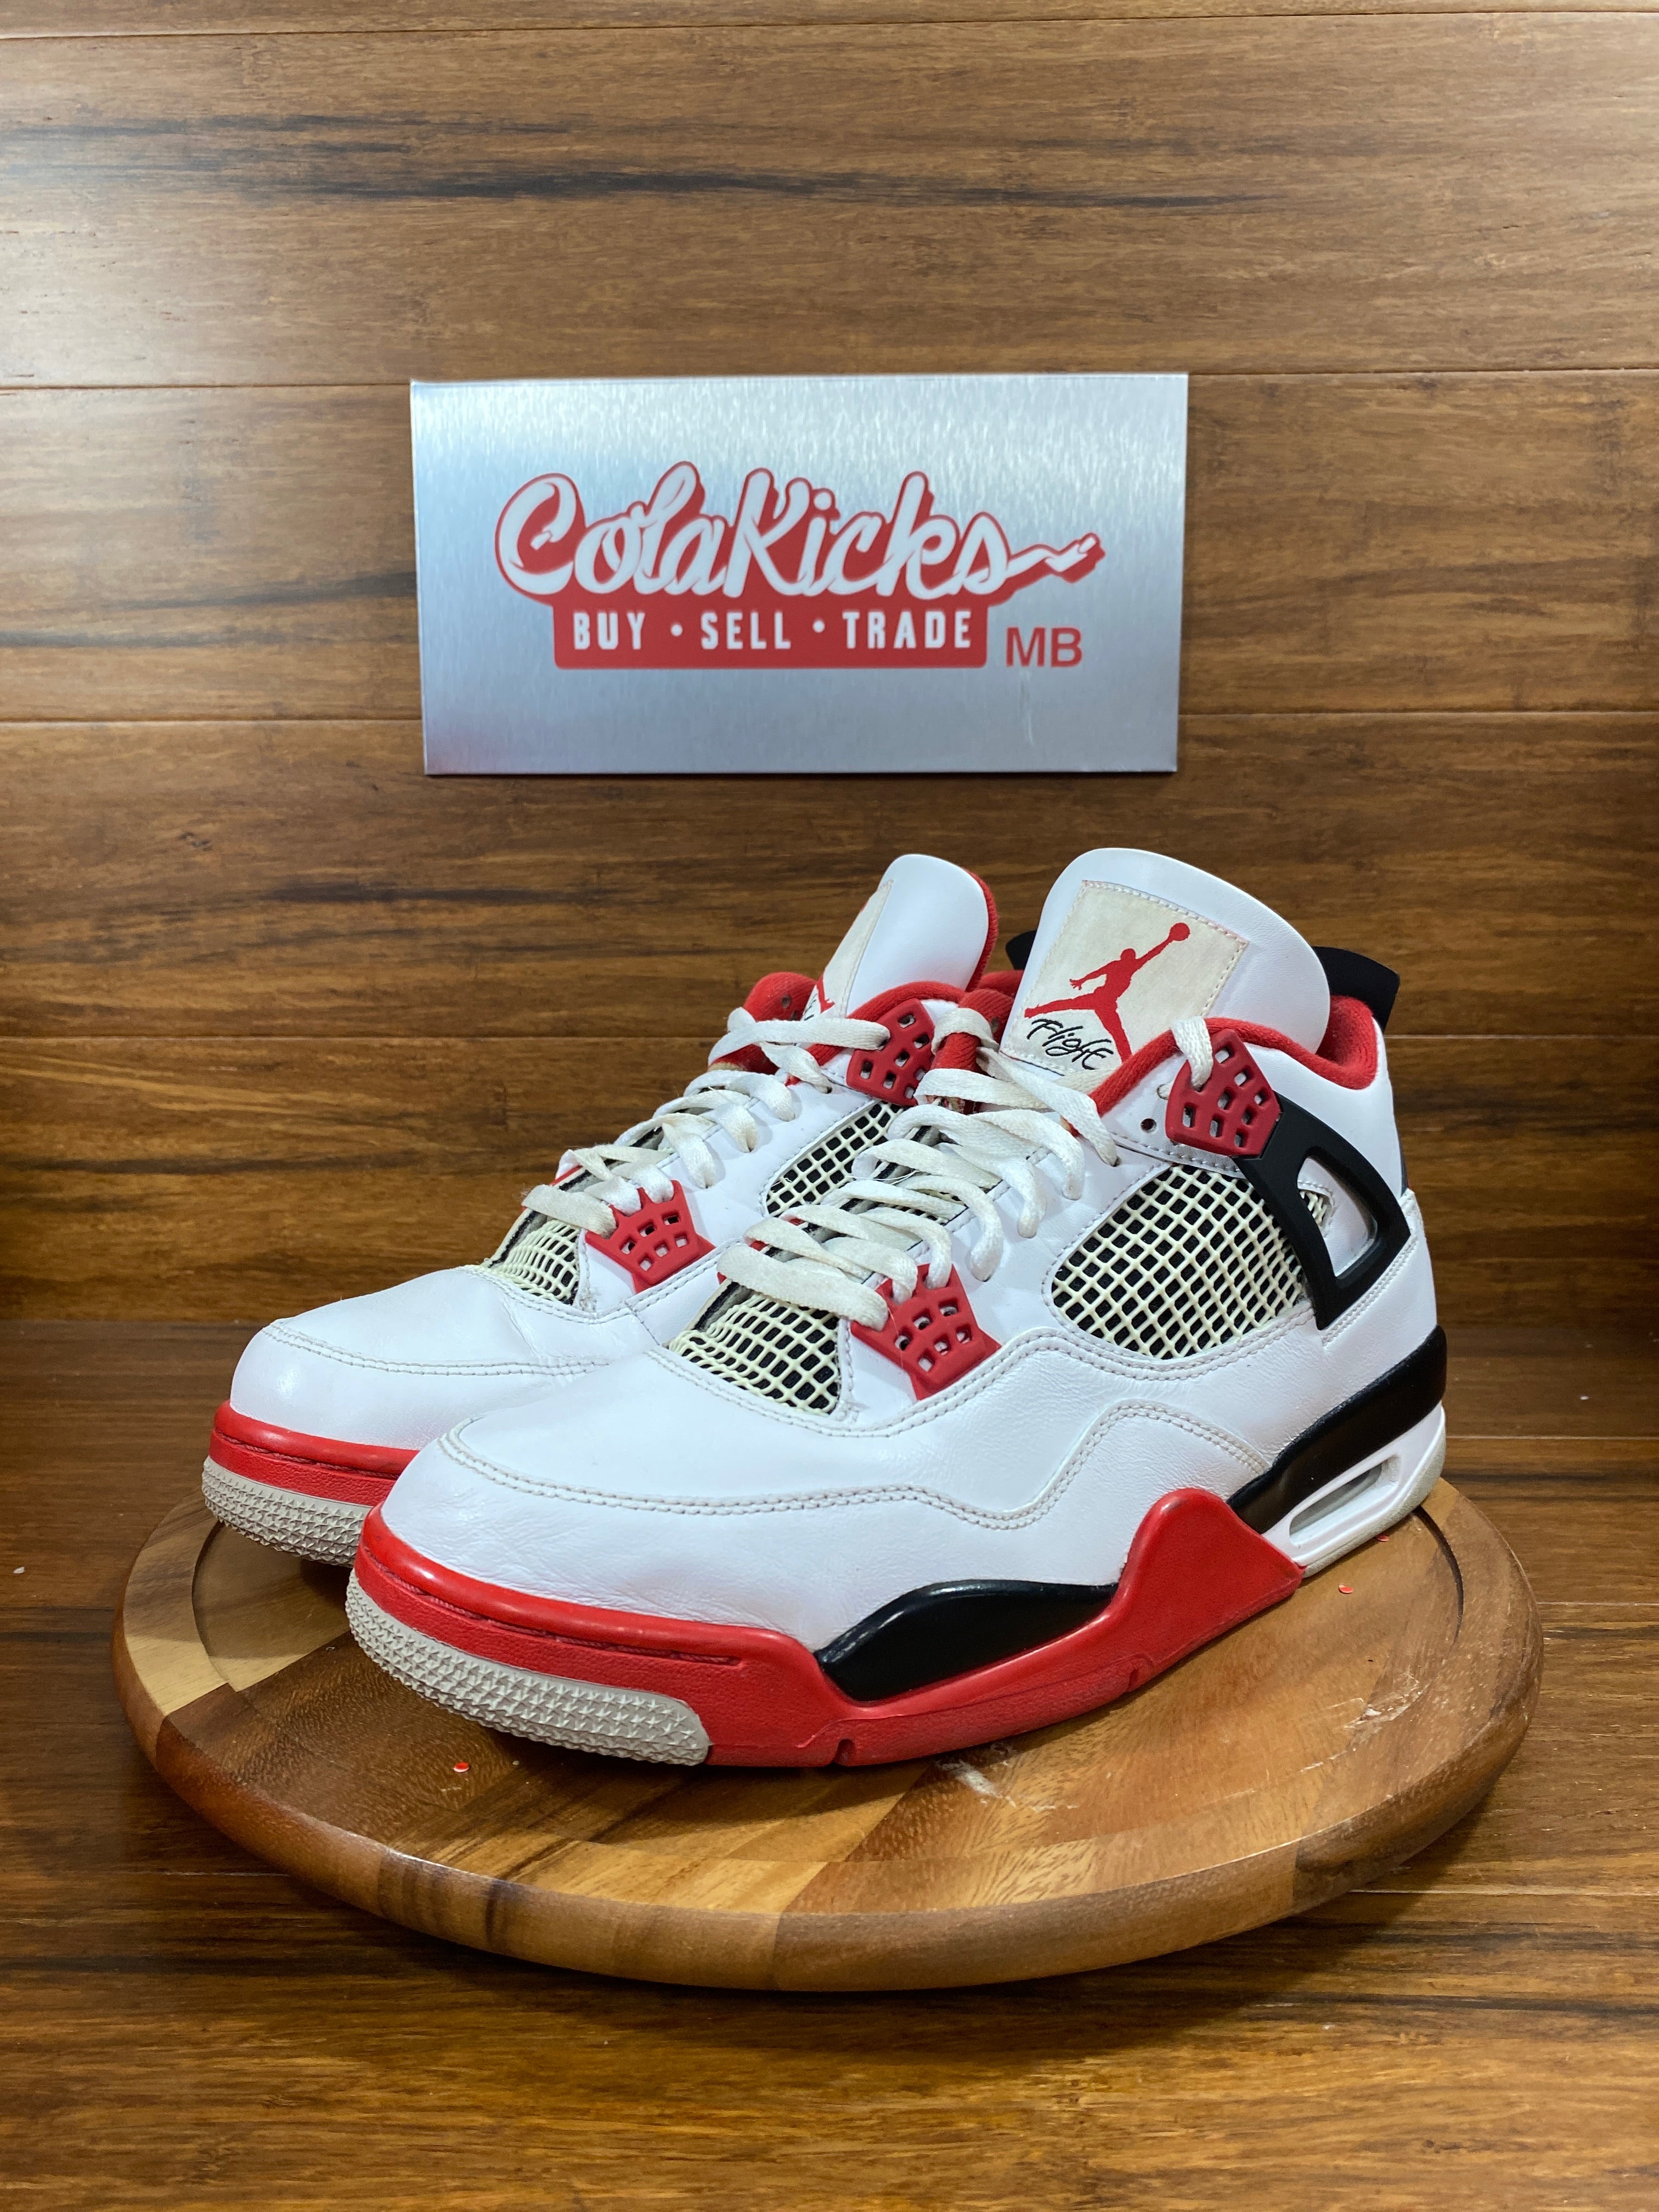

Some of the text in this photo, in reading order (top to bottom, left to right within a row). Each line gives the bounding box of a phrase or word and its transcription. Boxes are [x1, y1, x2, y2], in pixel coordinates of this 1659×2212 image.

[496, 461, 1098, 600] ColaKicks
[573, 610, 971, 650] BUY SELL TRADE
[1006, 627, 1083, 668] MB
